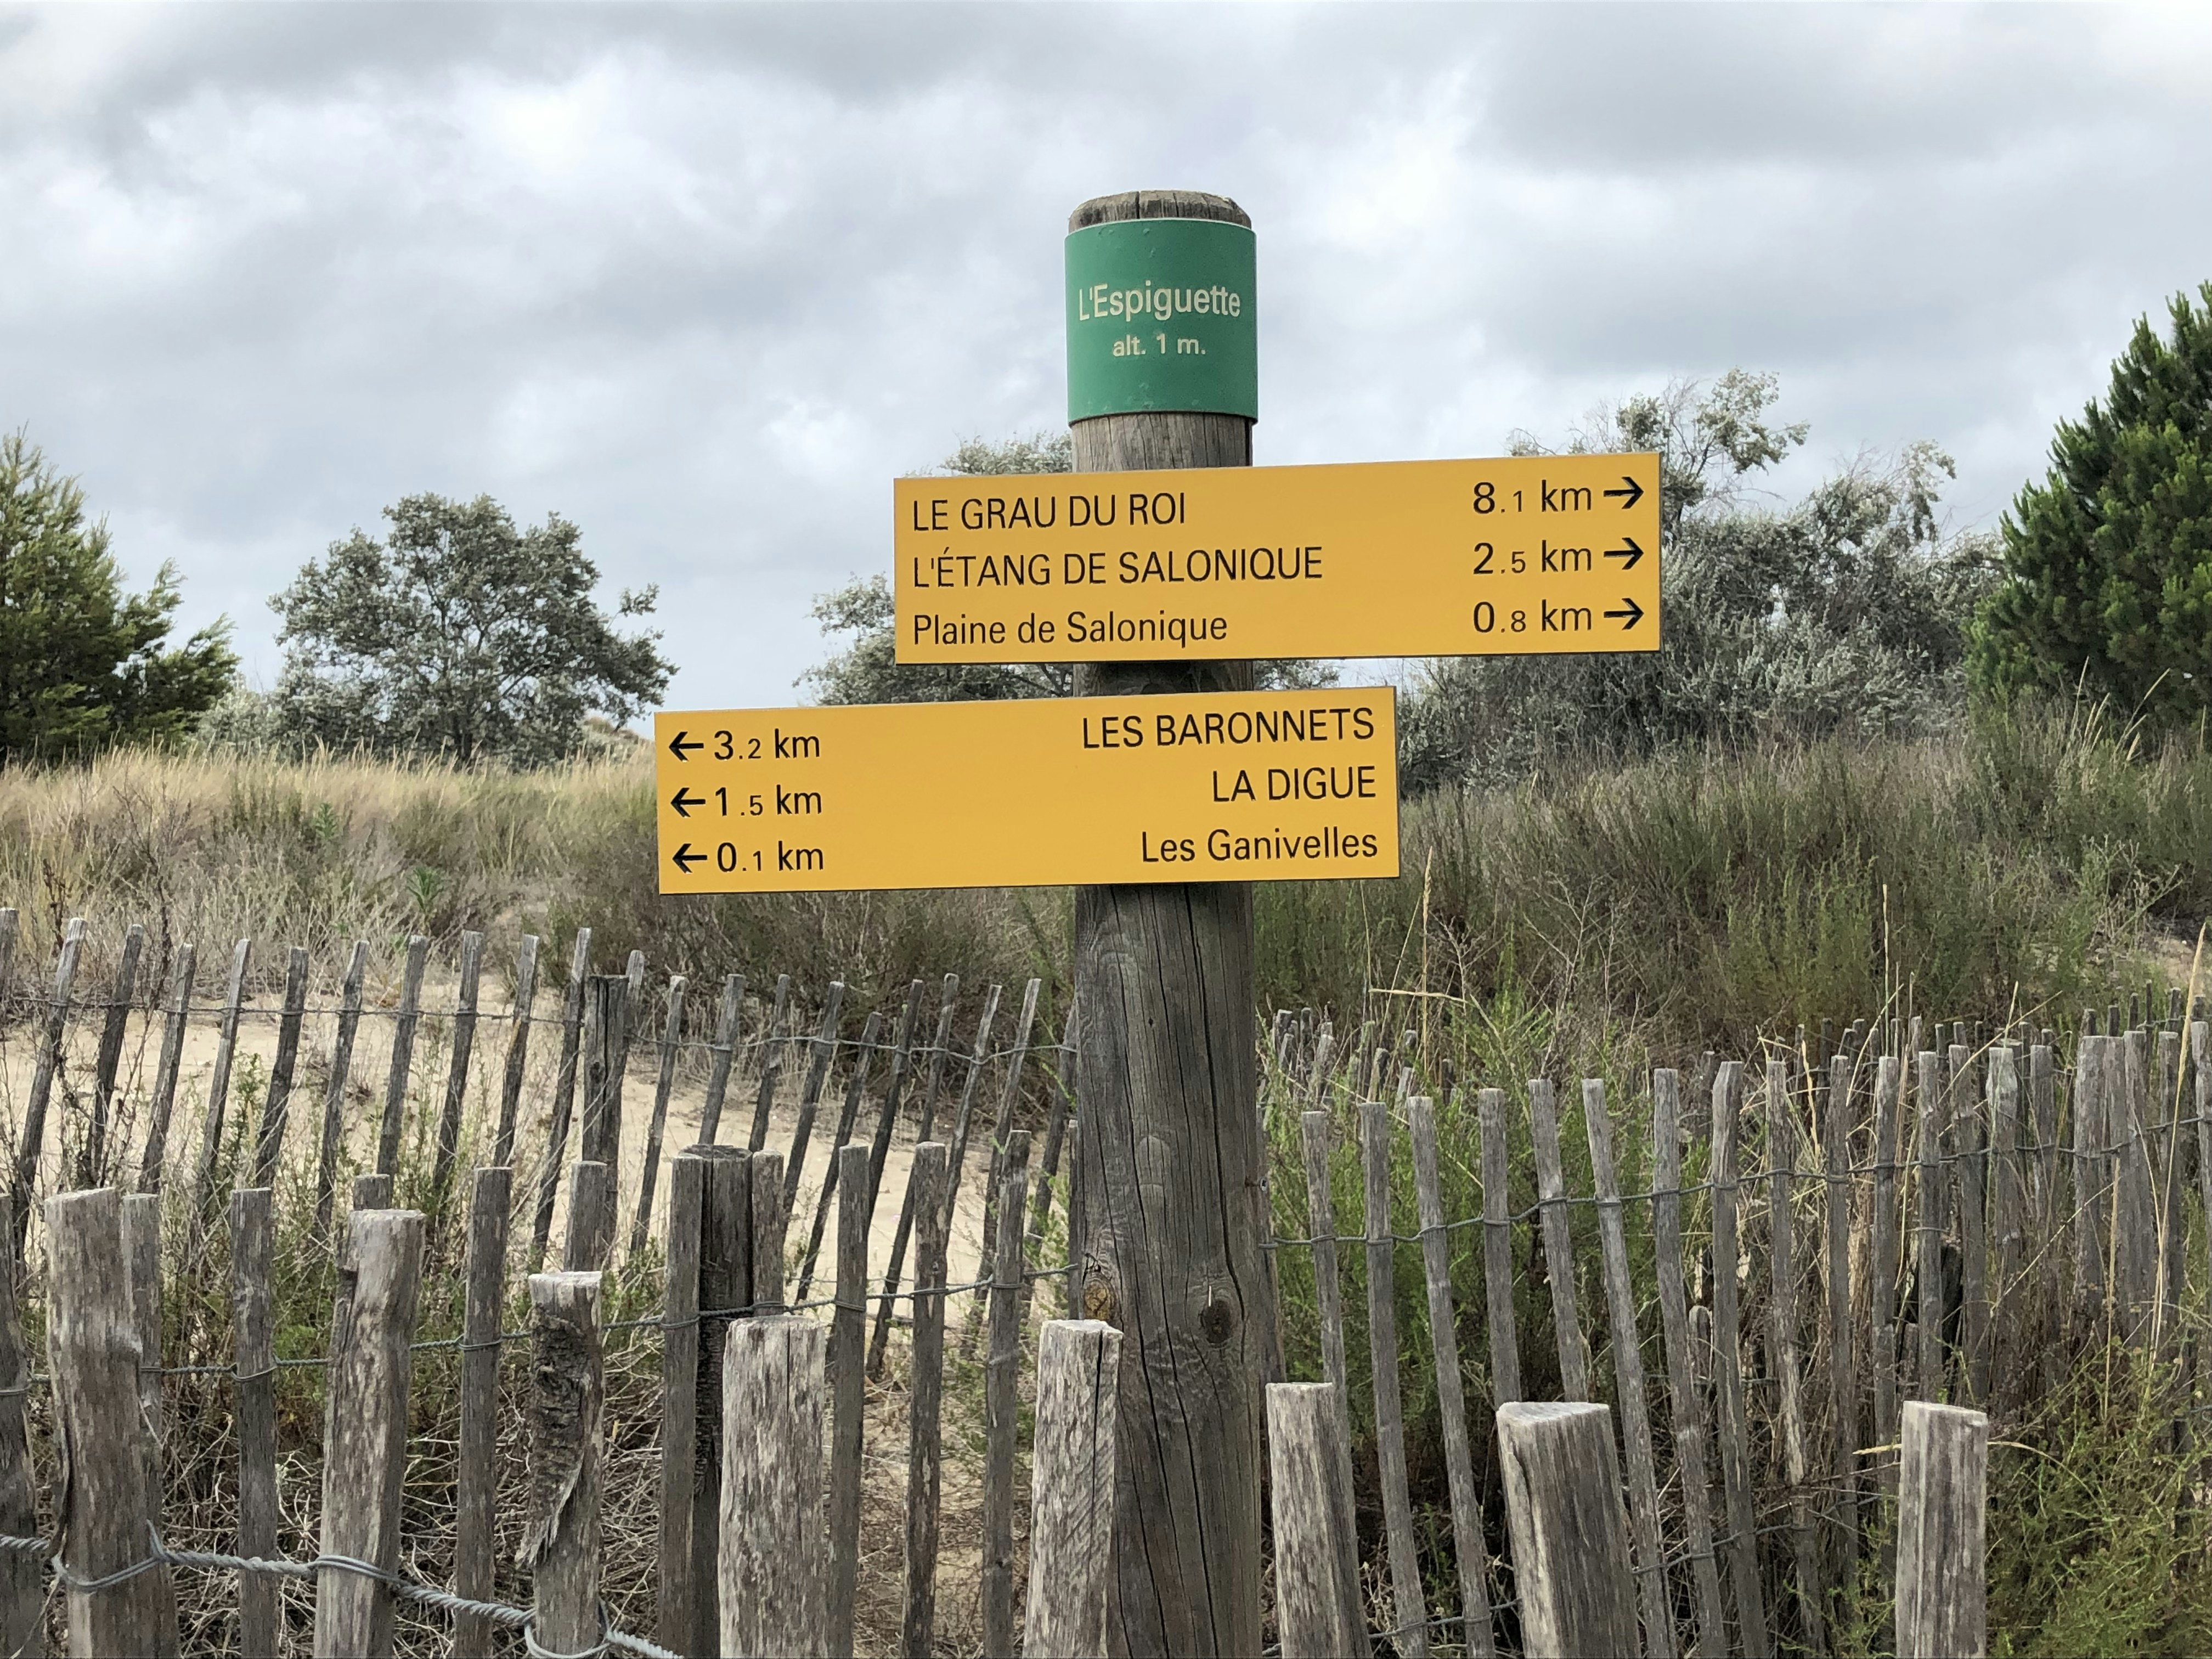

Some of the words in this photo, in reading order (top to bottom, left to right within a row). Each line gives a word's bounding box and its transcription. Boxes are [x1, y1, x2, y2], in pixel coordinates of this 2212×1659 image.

[1079, 280, 1240, 322] L'Espiguette
[1113, 334, 1146, 357] alt.
[1156, 333, 1165, 354] 1
[1177, 338, 1205, 354] m.
[913, 499, 949, 531] LE
[961, 496, 1056, 530] GRAU
[1069, 494, 1115, 527] DU
[1130, 492, 1184, 526] ROI
[1473, 482, 1522, 514] 8.1
[1542, 479, 1592, 512] km
[914, 546, 1050, 588] L'ÉTANG
[1064, 552, 1107, 585] DE
[1119, 546, 1322, 584] SALONIQUE
[1473, 542, 1526, 574] 2.5
[1542, 539, 1592, 573] km
[914, 613, 1006, 645] Plaine
[1018, 612, 1055, 644] de
[1067, 610, 1227, 648] Salonique
[1474, 601, 1526, 633] 0.8
[1542, 599, 1592, 631] km
[714, 730, 761, 760] 3.2
[774, 728, 820, 759] km
[1083, 715, 1143, 749] LES
[1156, 707, 1374, 746] BARONNETS
[715, 787, 763, 816] 1.5
[776, 784, 822, 815] km
[1213, 770, 1256, 802] LA
[1268, 765, 1376, 800] DIGUE
[717, 842, 761, 872] 0.1
[778, 840, 823, 871] km
[1142, 831, 1195, 862] Les
[1207, 826, 1378, 861] Ganivelles
